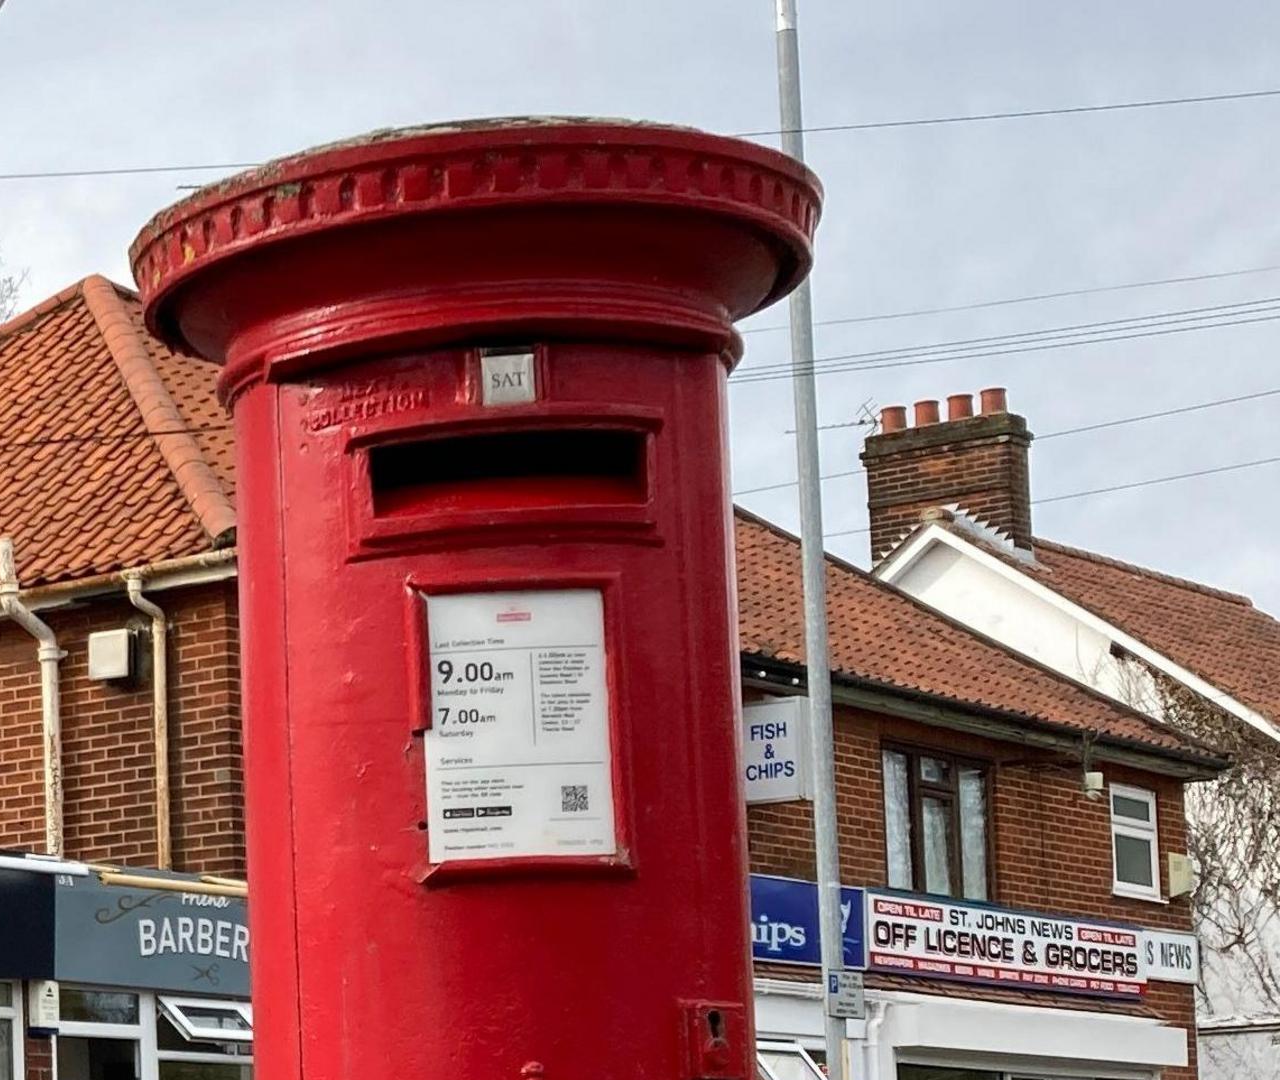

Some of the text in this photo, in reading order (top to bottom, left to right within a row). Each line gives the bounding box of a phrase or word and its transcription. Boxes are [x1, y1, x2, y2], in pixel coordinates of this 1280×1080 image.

[492, 371, 526, 389] SAT
[437, 660, 514, 684] 9.00am
[438, 707, 496, 725] 7.00am
[750, 721, 787, 741] FISH
[764, 743, 775, 760] &
[745, 760, 795, 781] CHIPS
[877, 900, 941, 921] OPEN TIL LATE
[949, 909, 1073, 941] ST. JOHNS NEWS
[874, 920, 917, 948] OFF
[924, 926, 1015, 963] LICENCE
[1022, 940, 1039, 966] &
[1045, 942, 1139, 977] GROCERS
[1160, 942, 1192, 970] NEWS
